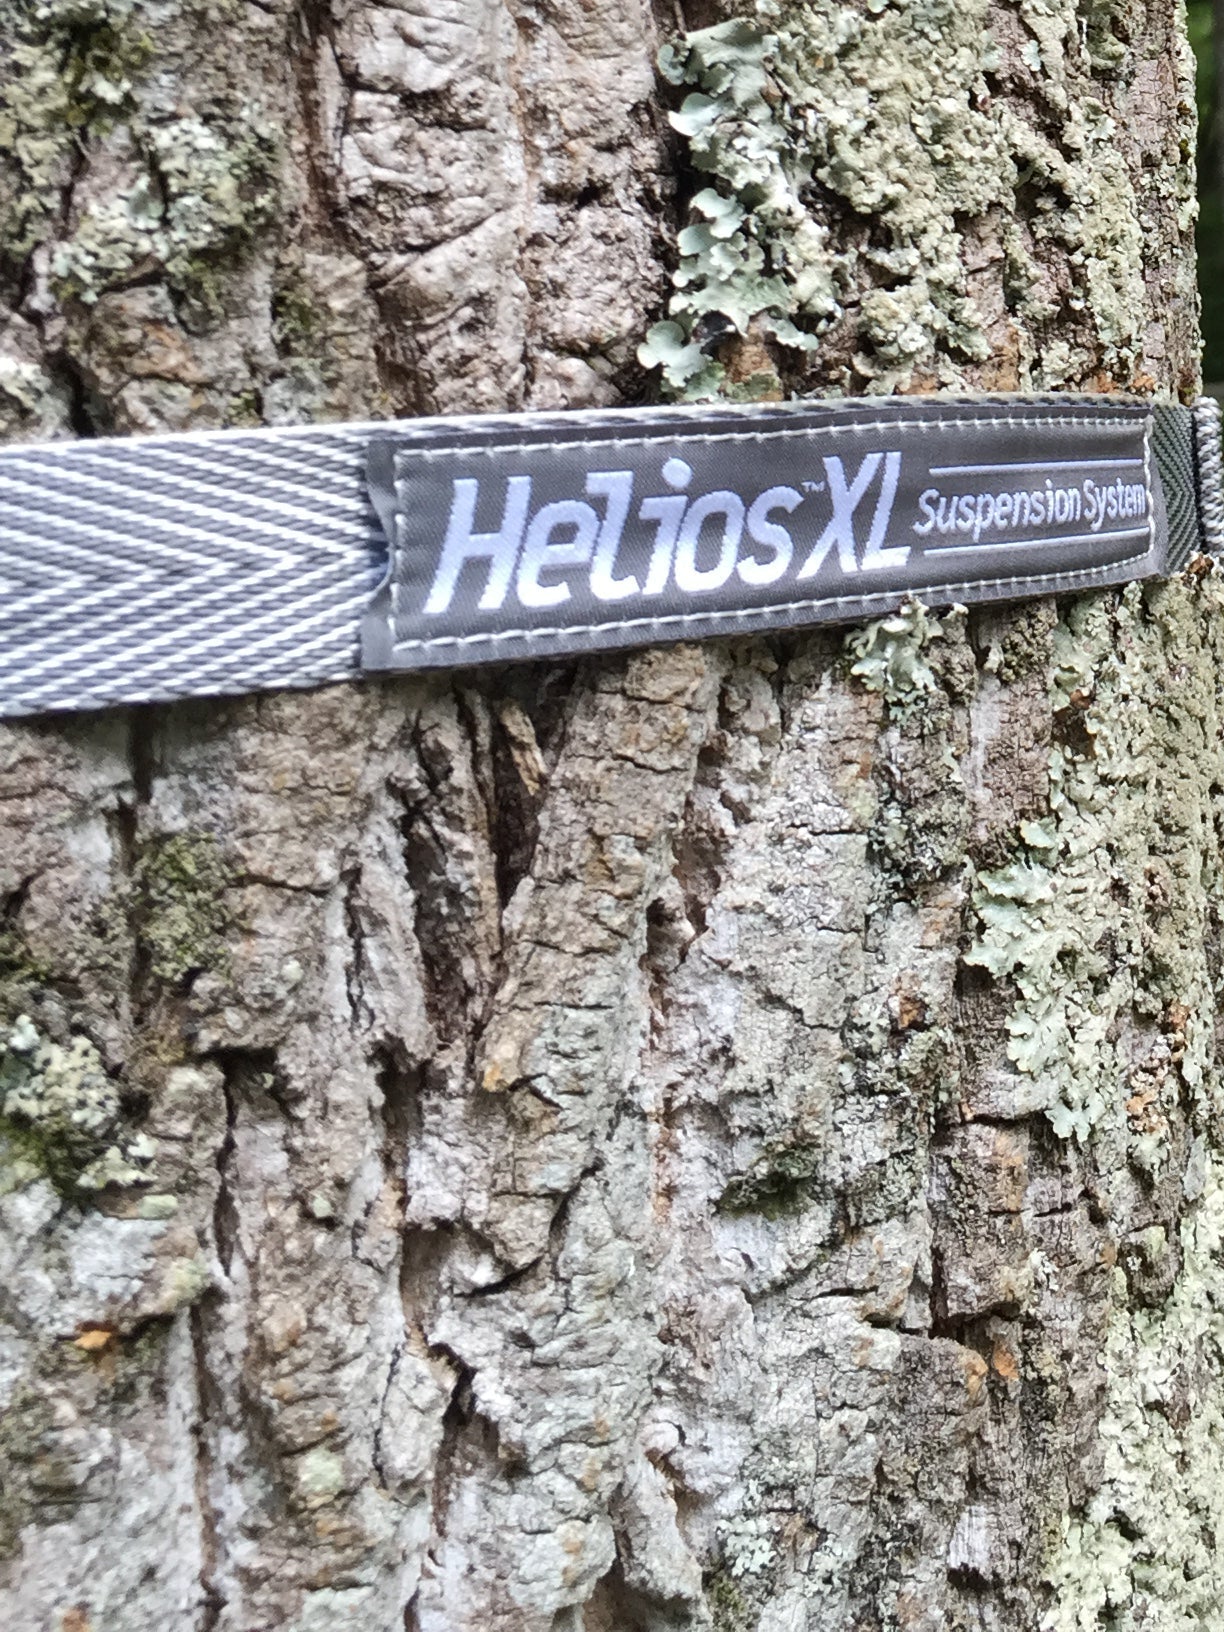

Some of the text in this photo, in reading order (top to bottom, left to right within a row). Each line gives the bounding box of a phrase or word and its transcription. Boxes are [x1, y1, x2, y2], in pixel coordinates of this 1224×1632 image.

[423, 457, 803, 614] Helios
[797, 451, 912, 579] XL
[913, 477, 1146, 542] Suspension System
